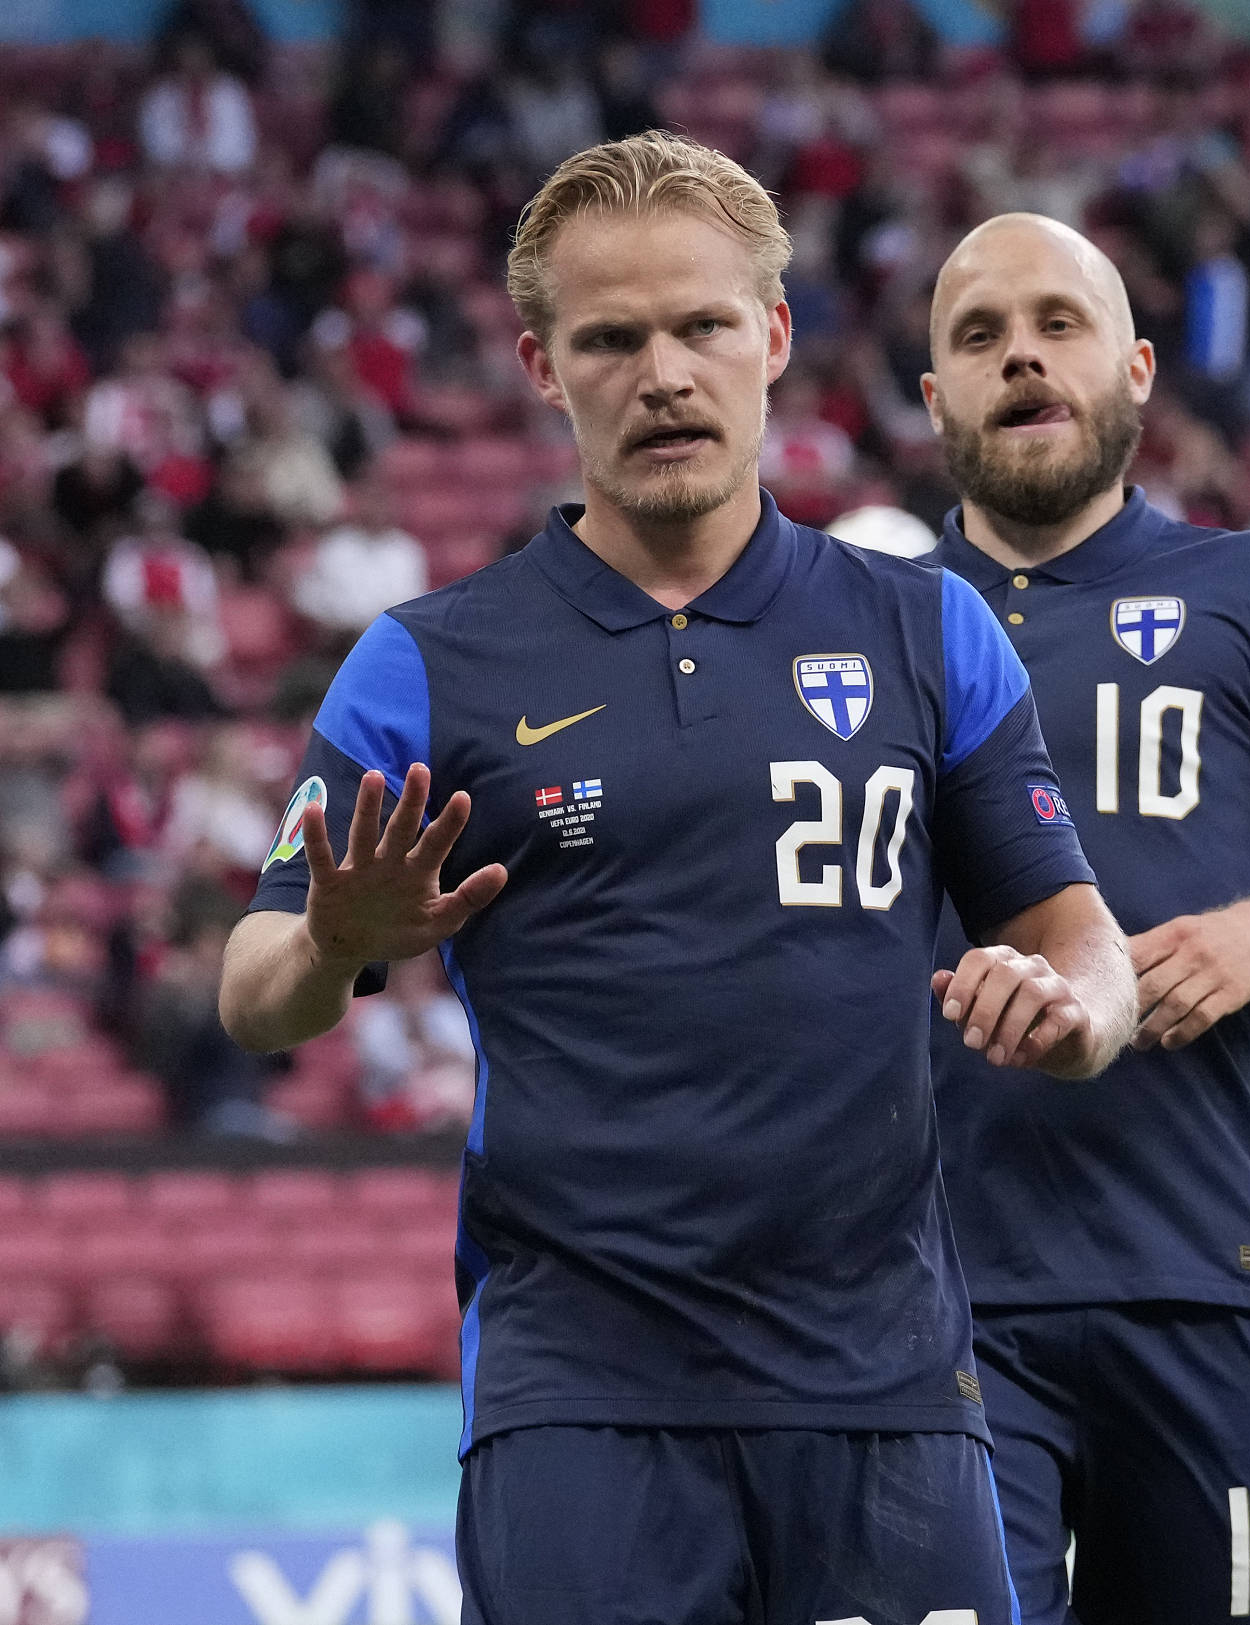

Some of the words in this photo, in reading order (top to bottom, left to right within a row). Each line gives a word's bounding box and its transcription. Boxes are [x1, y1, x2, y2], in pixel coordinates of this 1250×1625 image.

[806, 661, 856, 671] SUOMI
[1096, 682, 1204, 820] 10
[538, 806, 565, 819] DENMARK
[578, 800, 602, 811] FINLAND
[550, 818, 564, 828] UEFA
[564, 816, 579, 825] EURO
[580, 813, 595, 822] 2020
[559, 837, 594, 848] COPENHAGEN
[769, 760, 915, 911] 20
